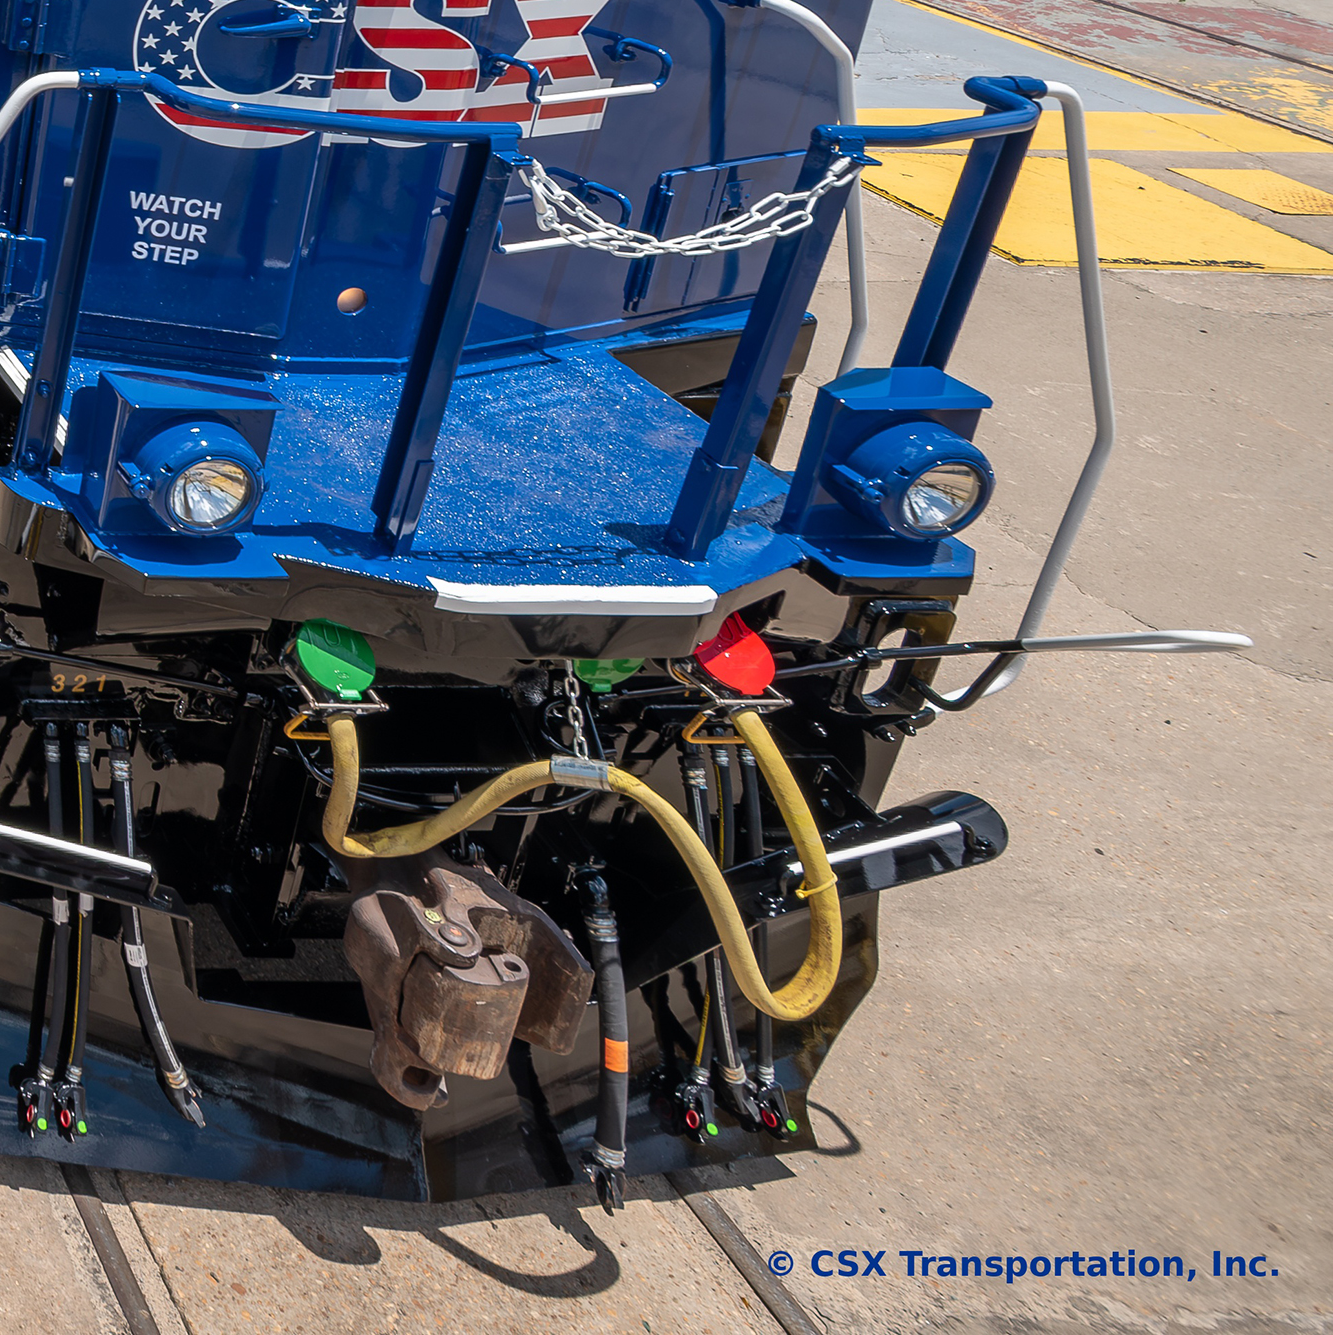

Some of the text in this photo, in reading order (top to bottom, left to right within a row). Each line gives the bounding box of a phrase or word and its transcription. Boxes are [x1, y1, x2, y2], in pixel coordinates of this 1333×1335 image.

[129, 190, 222, 221] WATCH
[134, 215, 208, 244] YOUR
[131, 240, 200, 266] STEP
[51, 674, 107, 692] 3 2 1
